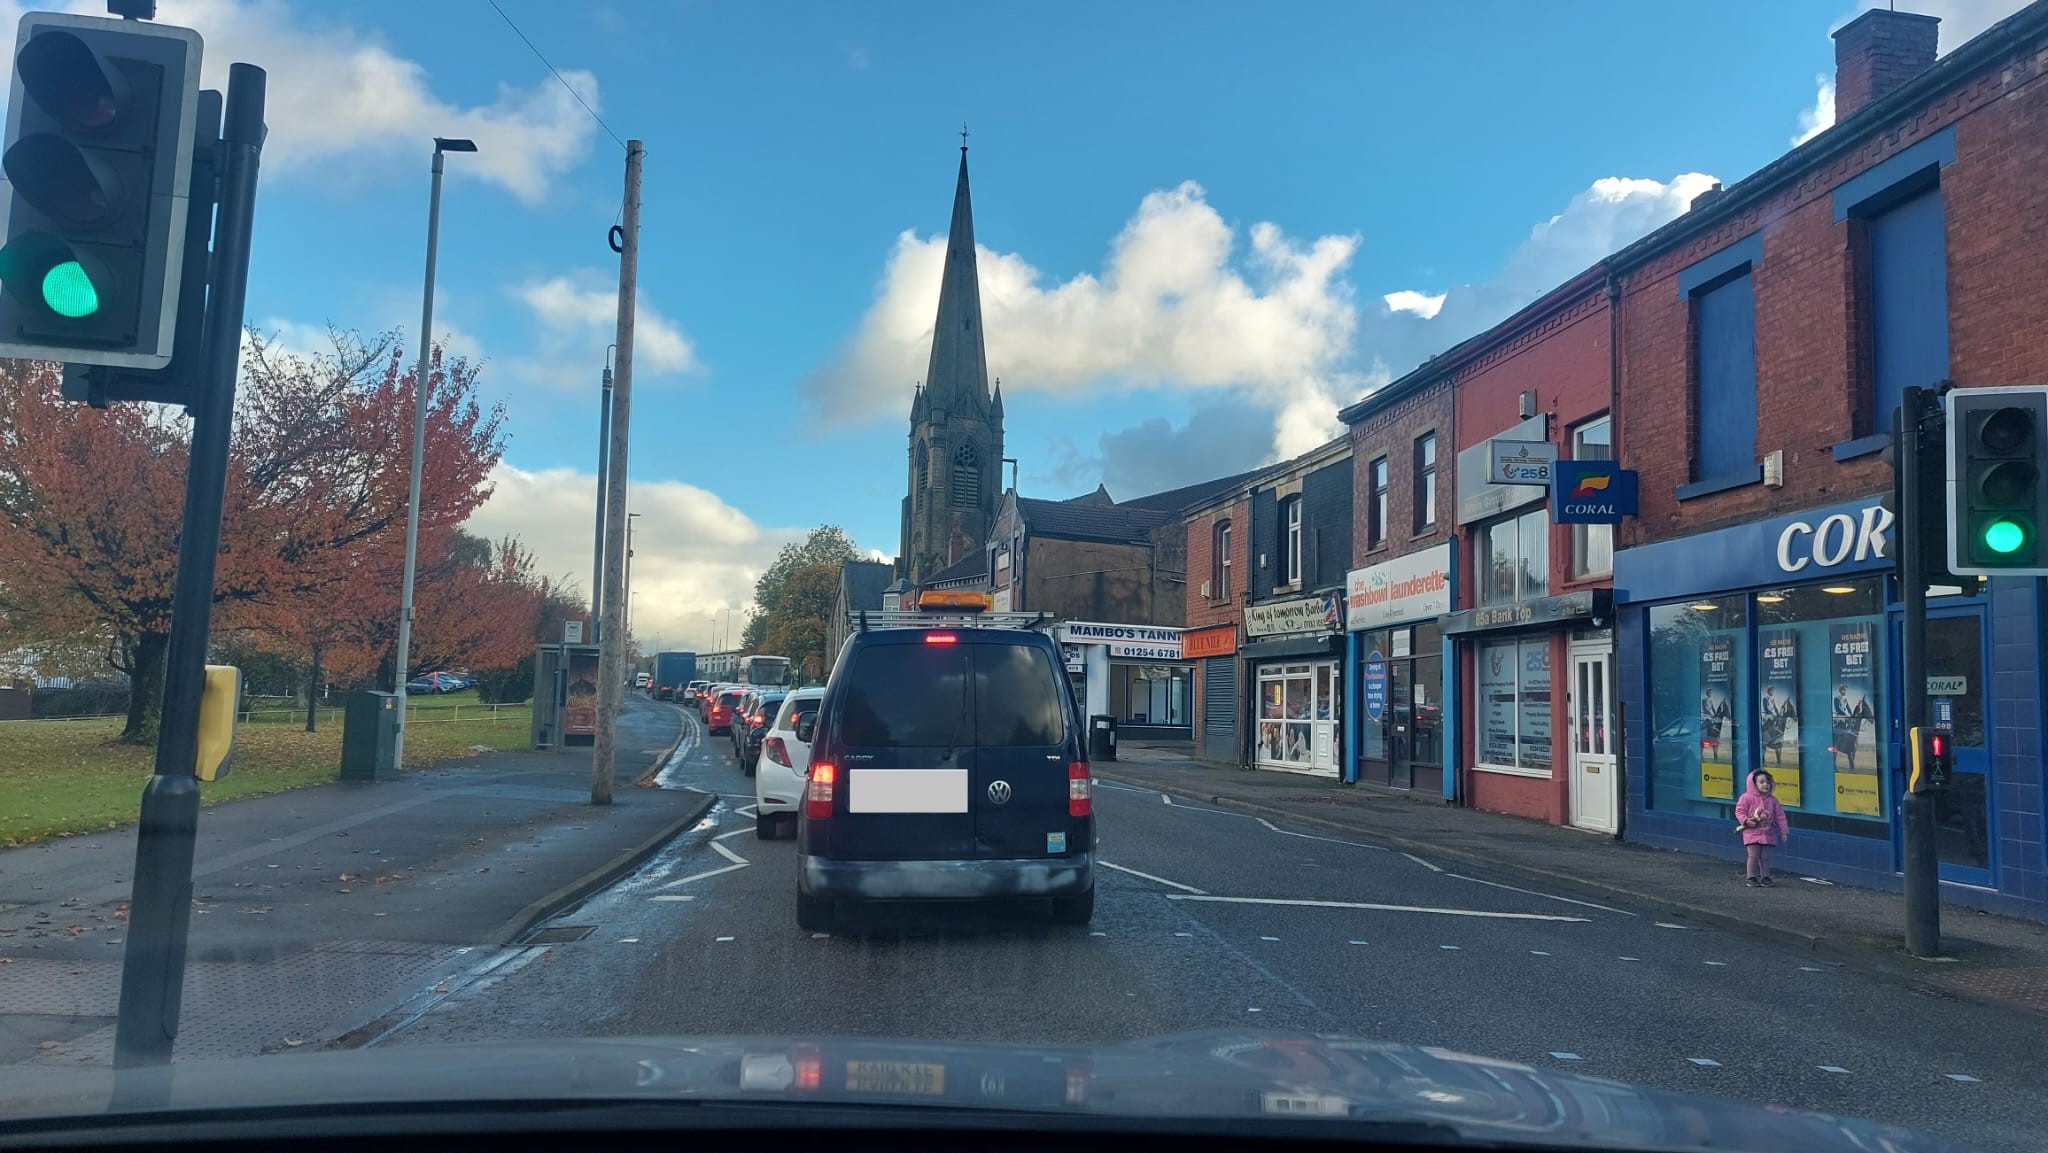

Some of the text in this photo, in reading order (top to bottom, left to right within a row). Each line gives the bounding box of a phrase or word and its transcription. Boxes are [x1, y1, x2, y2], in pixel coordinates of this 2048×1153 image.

[1565, 504, 1615, 515] CORAL
[1777, 506, 1896, 572] COR
[1350, 570, 1446, 608] washbowl launderette
[1355, 578, 1365, 591] the
[1252, 600, 1324, 624] King of tomorrow Barbe
[1492, 608, 1513, 623] Bank
[1515, 606, 1532, 621] Top
[1070, 625, 1181, 641] MAMBO'S TANNI
[1124, 646, 1181, 658] 01254 6781
[1764, 648, 1776, 658] £5
[1834, 643, 1849, 654] £5
[1703, 653, 1714, 662] £5
[1773, 658, 1788, 668] BET
[1846, 654, 1863, 665] BET
[1711, 662, 1724, 672] BET
